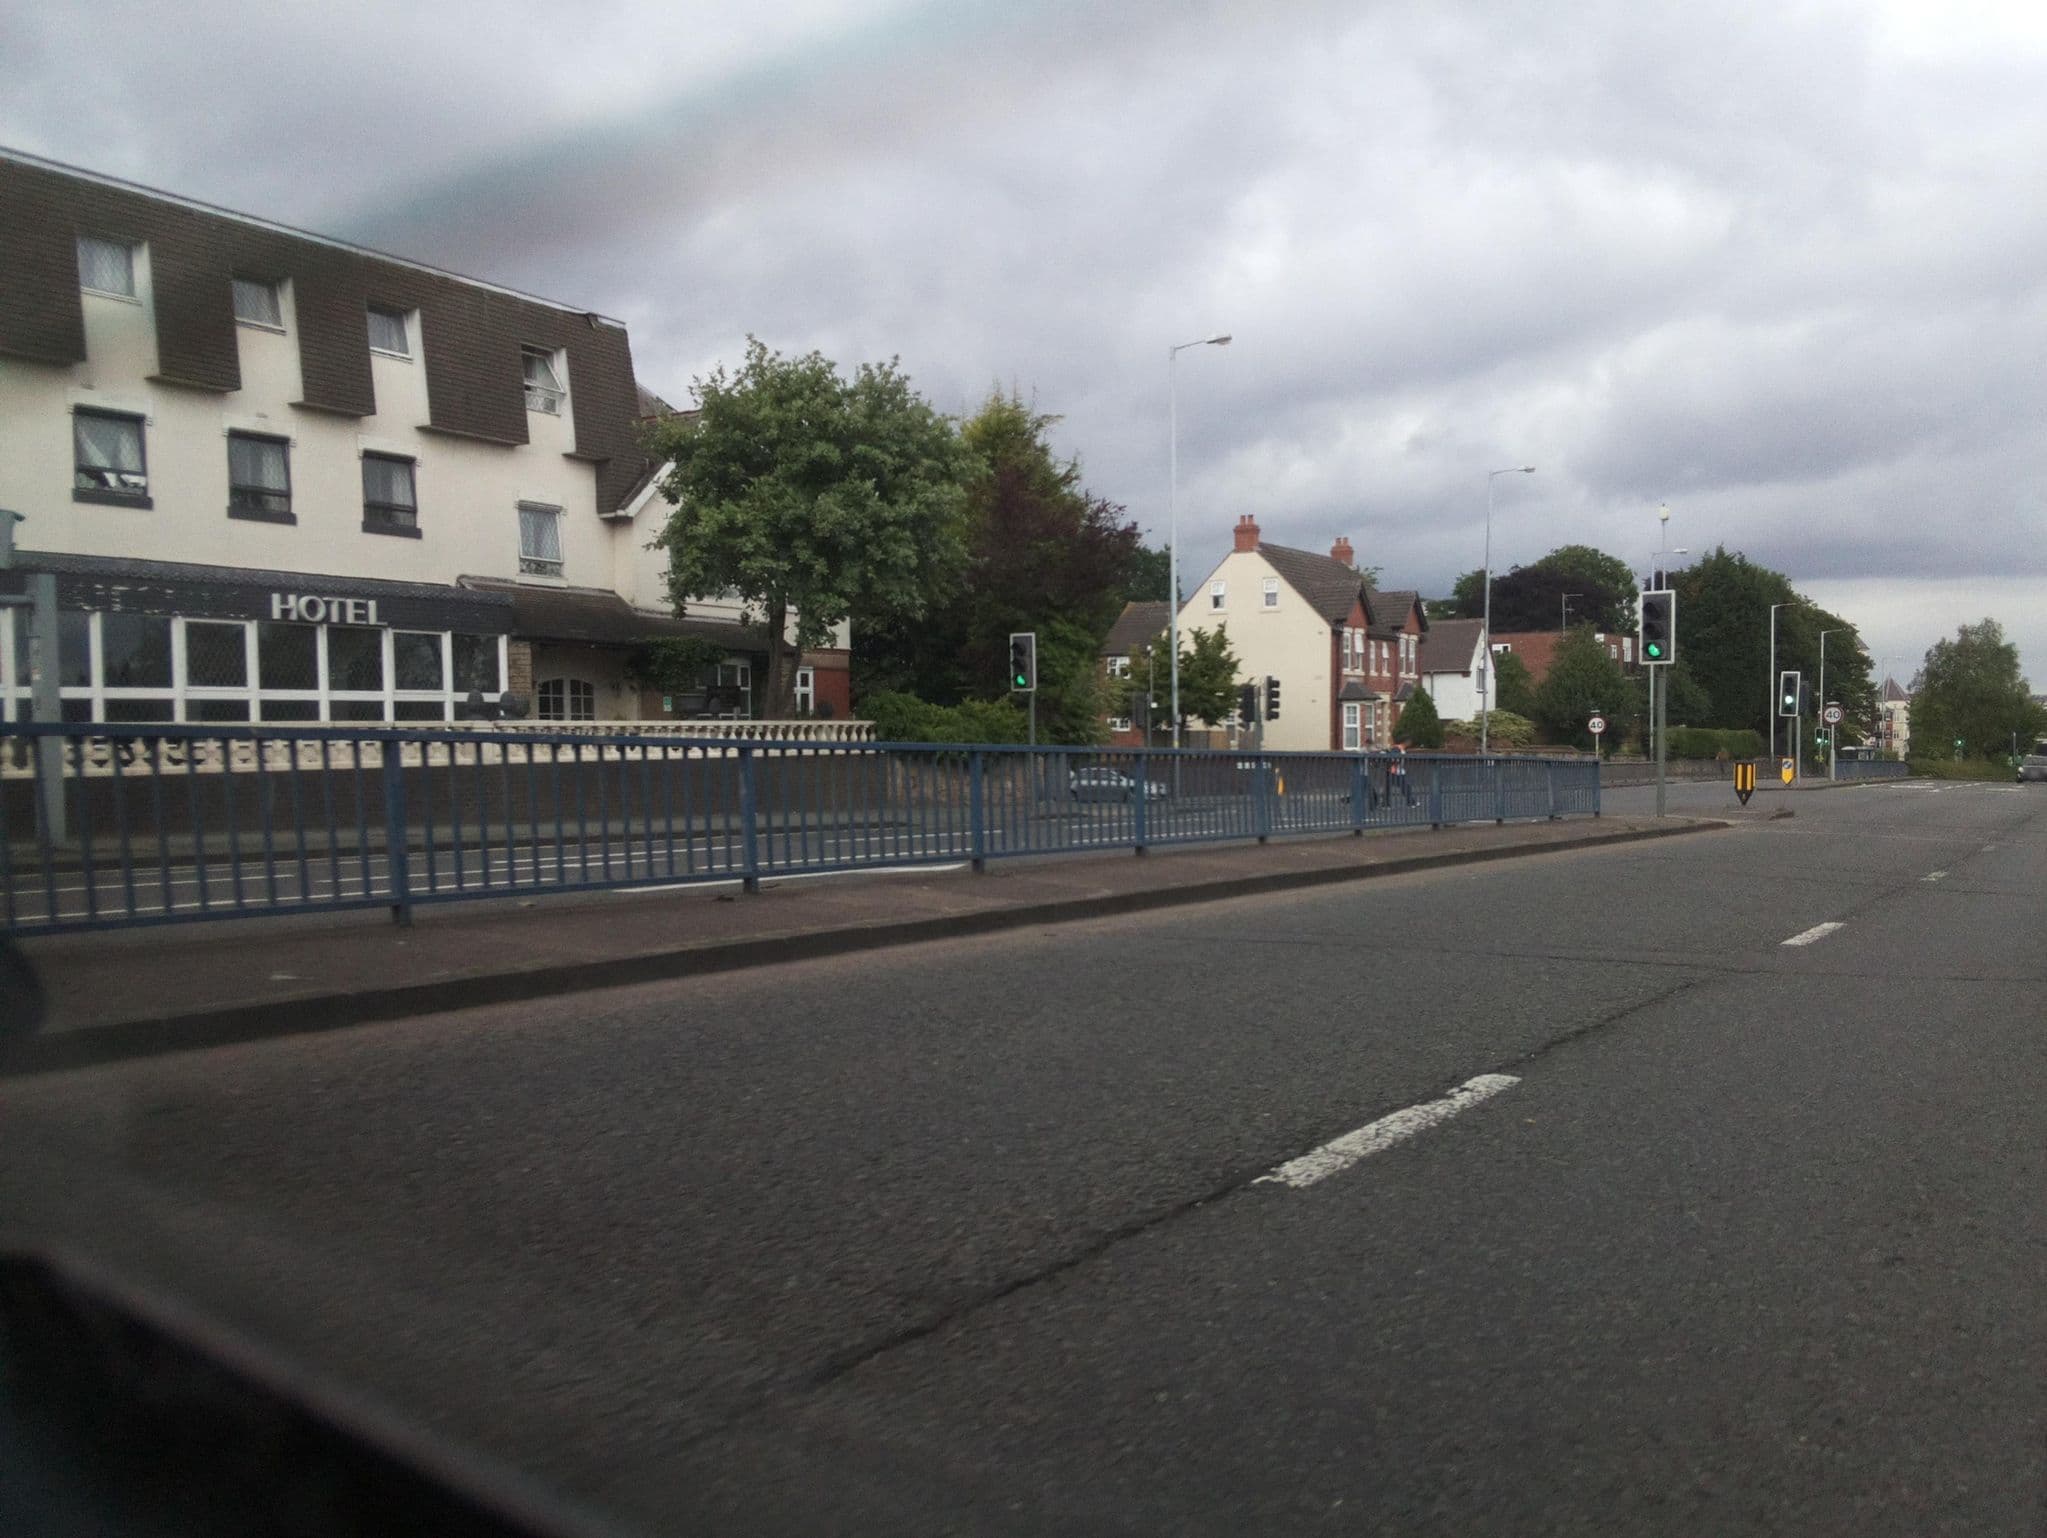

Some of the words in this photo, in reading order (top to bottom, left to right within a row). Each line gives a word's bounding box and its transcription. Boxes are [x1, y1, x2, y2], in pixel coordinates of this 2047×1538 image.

[271, 593, 388, 625] HOTEL
[1826, 710, 1840, 719] 40
[1590, 721, 1603, 729] 40
